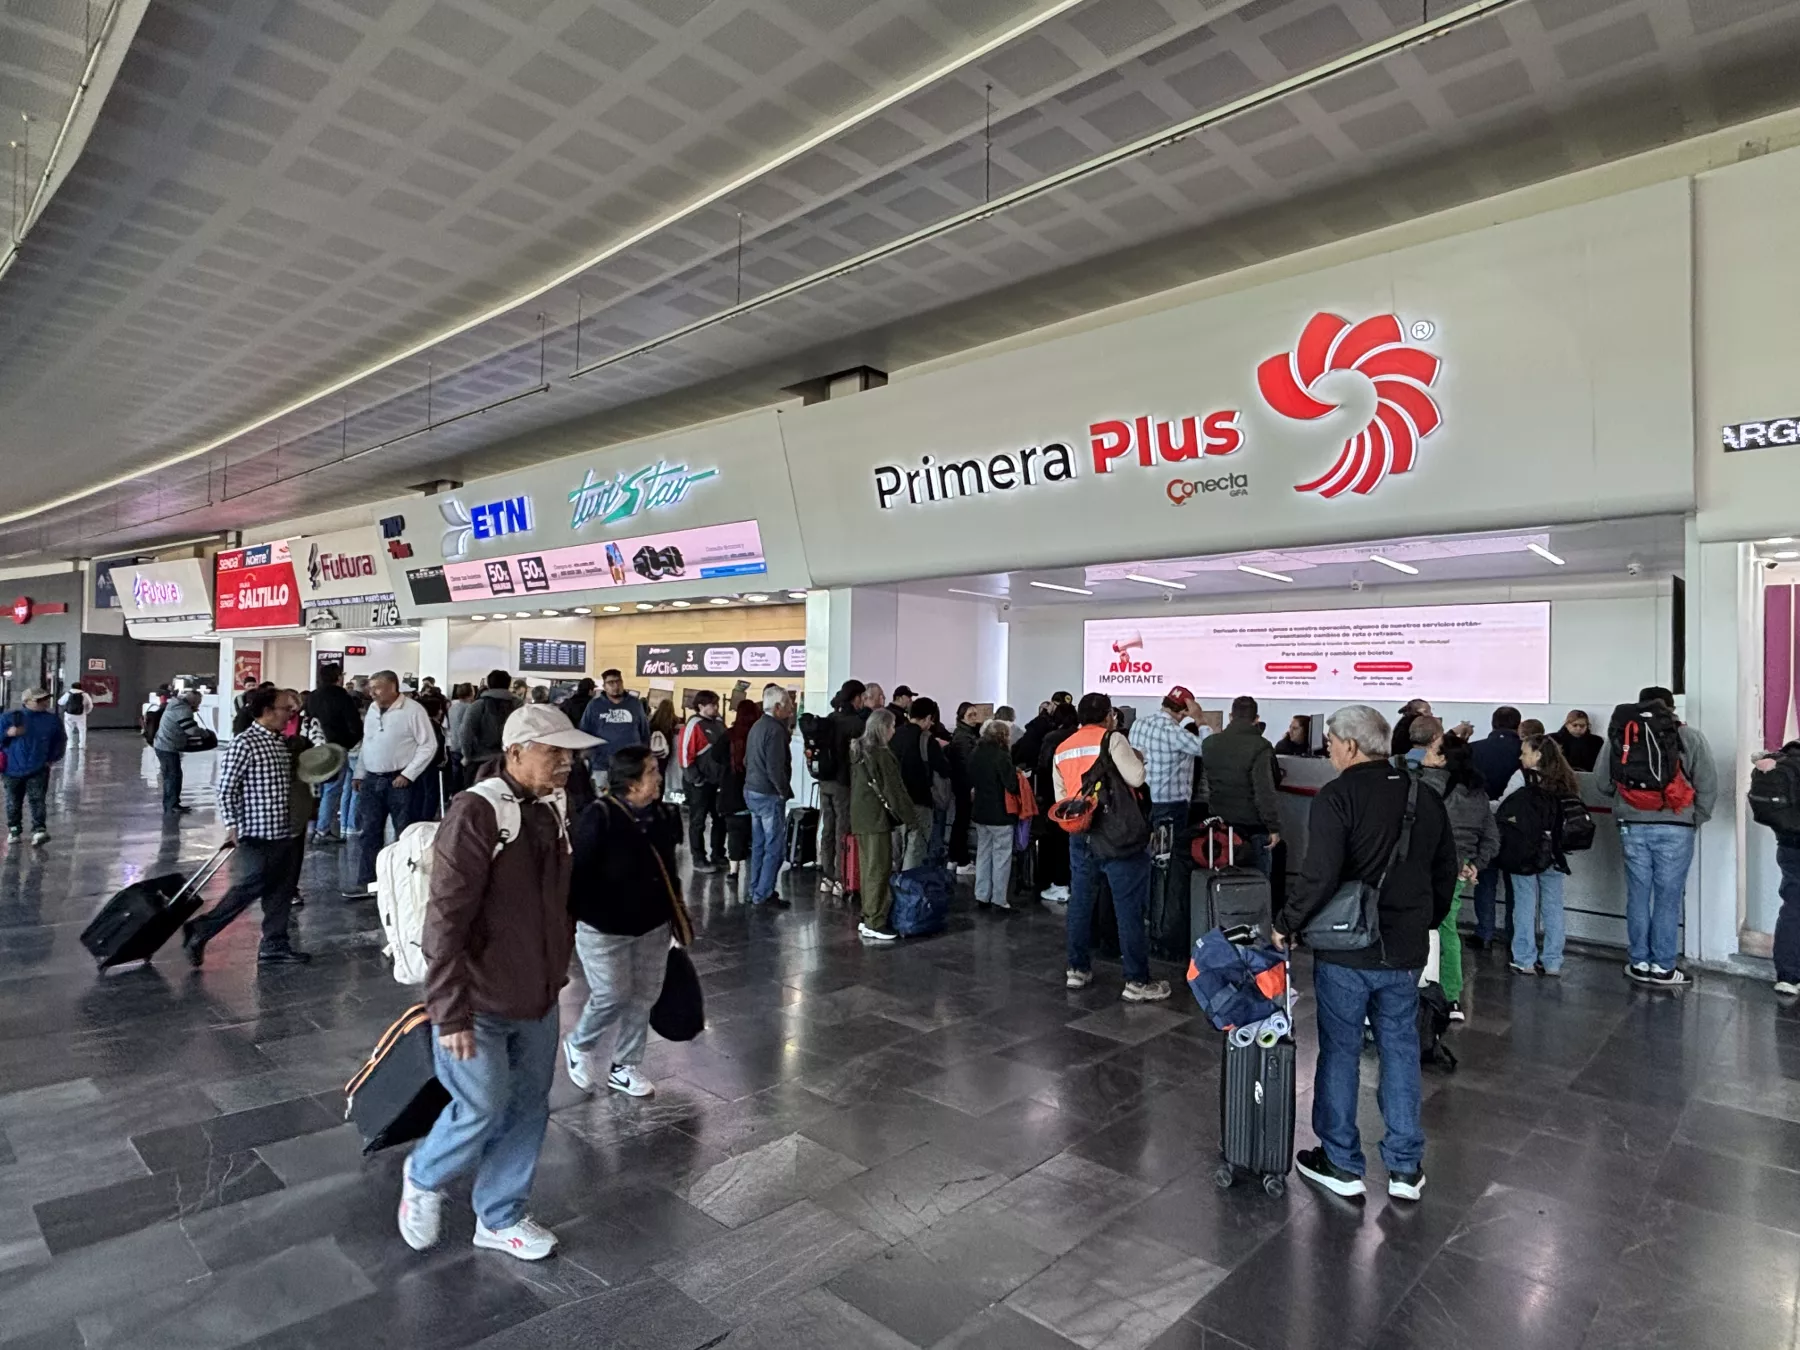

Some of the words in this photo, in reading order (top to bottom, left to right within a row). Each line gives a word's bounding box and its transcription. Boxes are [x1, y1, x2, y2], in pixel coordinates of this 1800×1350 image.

[1723, 419, 1800, 449] ARG
[874, 438, 1078, 510] Primera
[1089, 410, 1244, 475] Plus
[1166, 472, 1248, 505] Conecta
[1229, 488, 1249, 498] GFA
[471, 495, 532, 540] ETN
[320, 553, 377, 582] Futura
[141, 580, 181, 603] Futura
[238, 583, 289, 610] SALTILLO
[686, 650, 694, 662] 3
[1109, 662, 1152, 672] AVISO
[1099, 674, 1163, 684] IMPORTANTE
